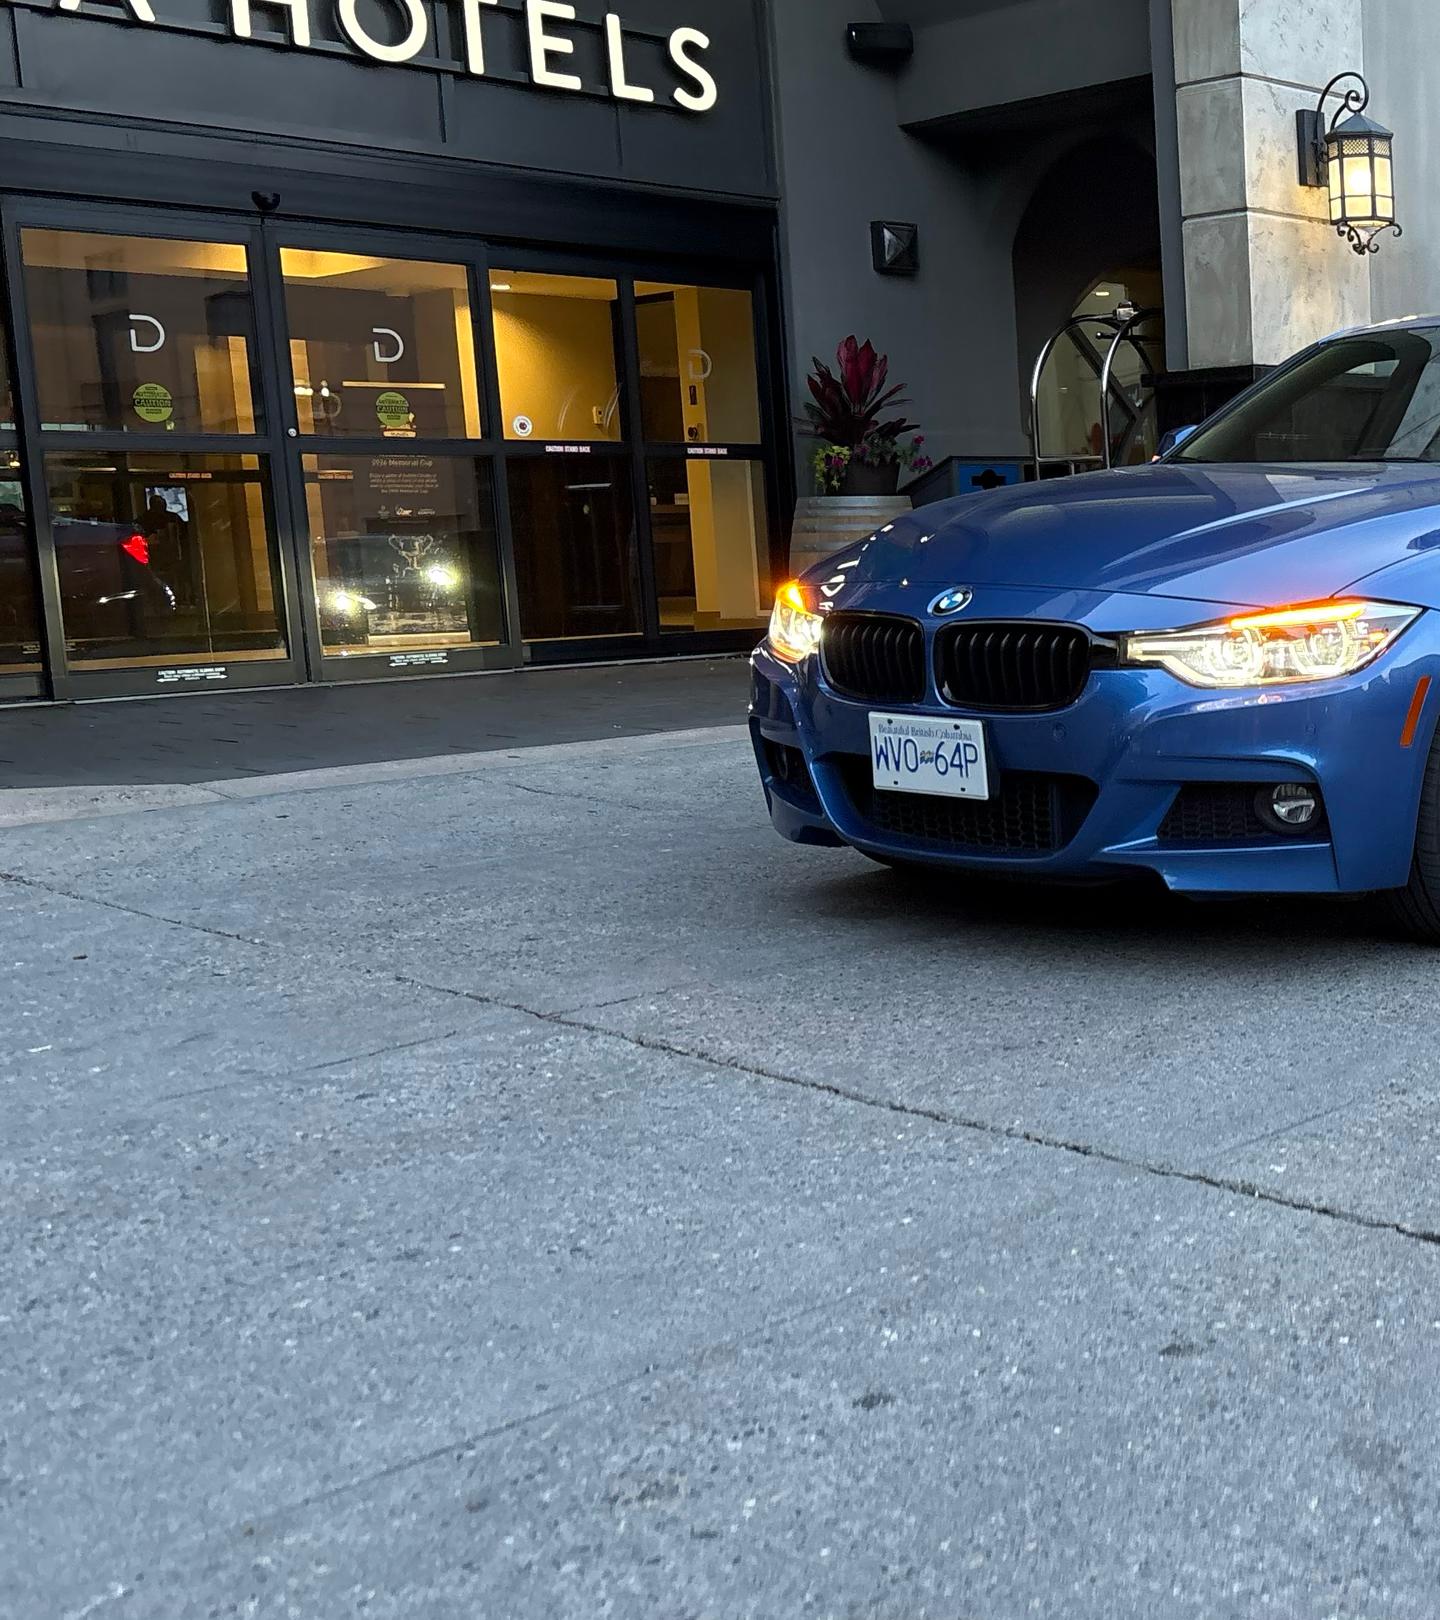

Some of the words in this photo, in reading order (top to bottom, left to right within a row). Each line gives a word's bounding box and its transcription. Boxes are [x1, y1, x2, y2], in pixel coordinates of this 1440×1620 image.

[129, 314, 165, 352] D
[373, 328, 404, 363] D
[134, 399, 171, 407] CAUTION
[878, 723, 910, 736] Beautiful
[911, 726, 934, 738] British
[936, 728, 972, 740] Columbia
